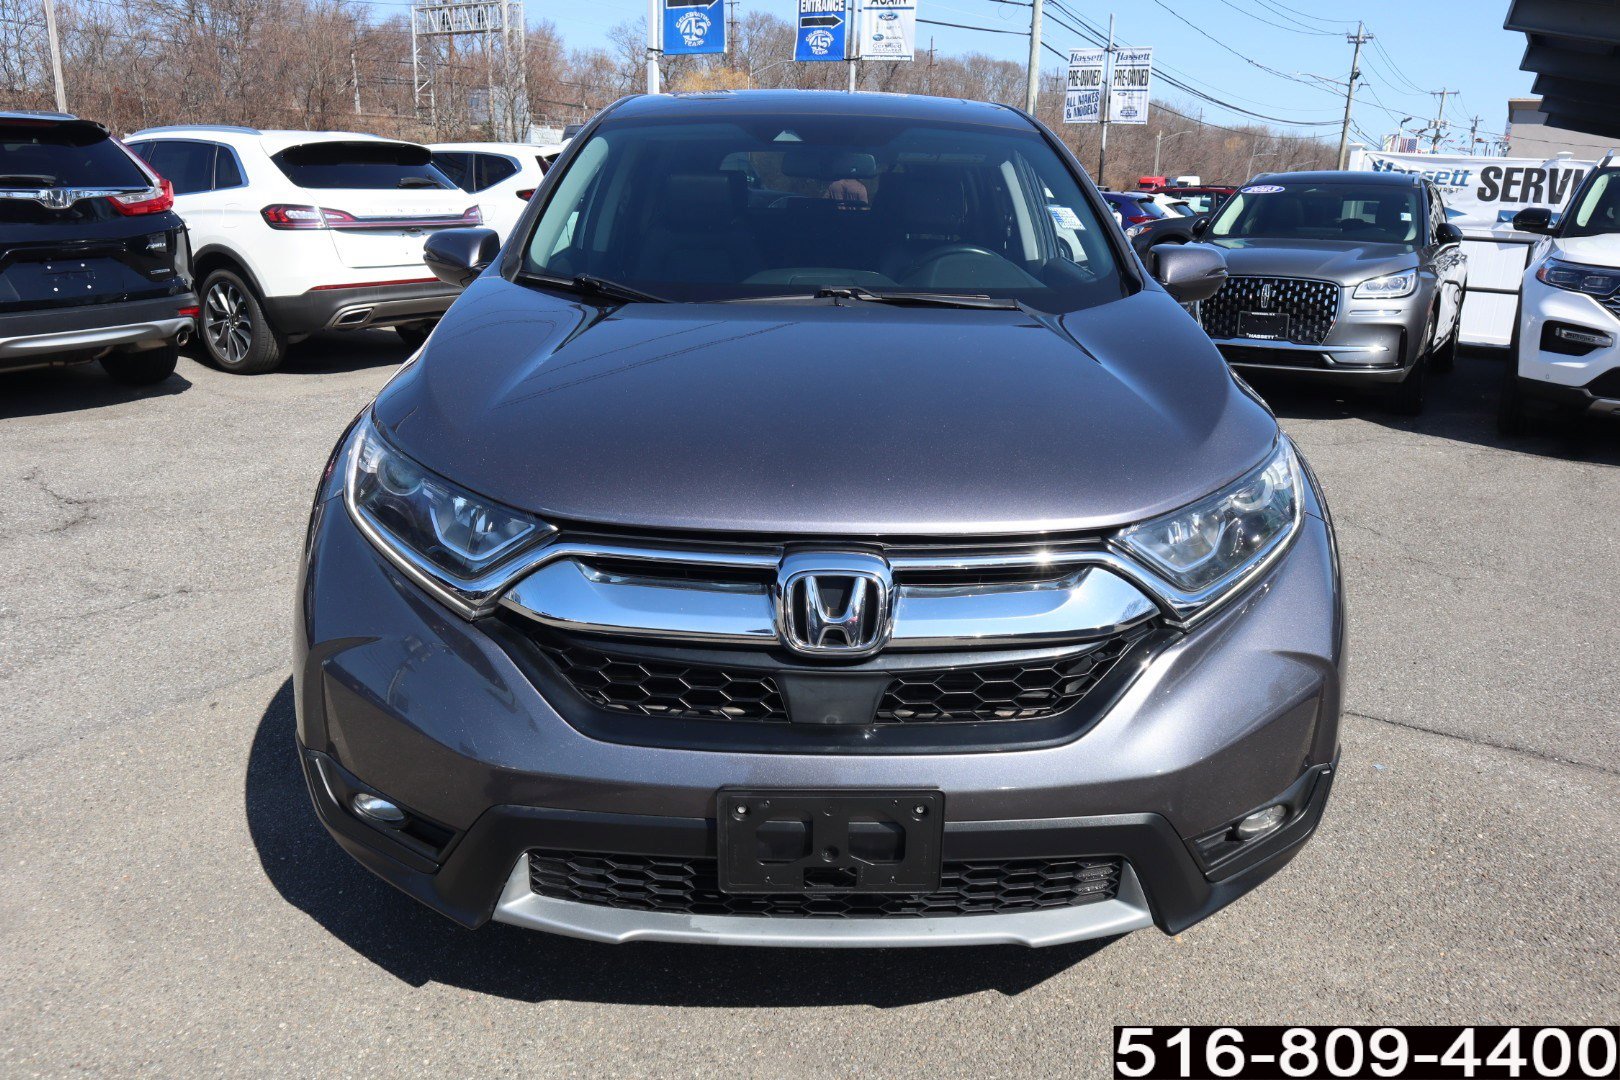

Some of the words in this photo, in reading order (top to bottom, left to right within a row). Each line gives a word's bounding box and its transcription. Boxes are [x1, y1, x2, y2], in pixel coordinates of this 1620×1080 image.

[800, 0, 844, 13] ENTRANCE
[675, 11, 712, 28] CELEBRATING
[682, 19, 706, 39] 45
[684, 38, 705, 47] YEARS
[811, 35, 829, 50] 45
[1068, 70, 1101, 87] PRE-OWNED
[1114, 69, 1149, 87] PRE-OWNED
[1066, 97, 1076, 108] ALL
[1079, 92, 1100, 104] MAKES
[1066, 108, 1072, 119] &
[1073, 103, 1098, 118] MODELS
